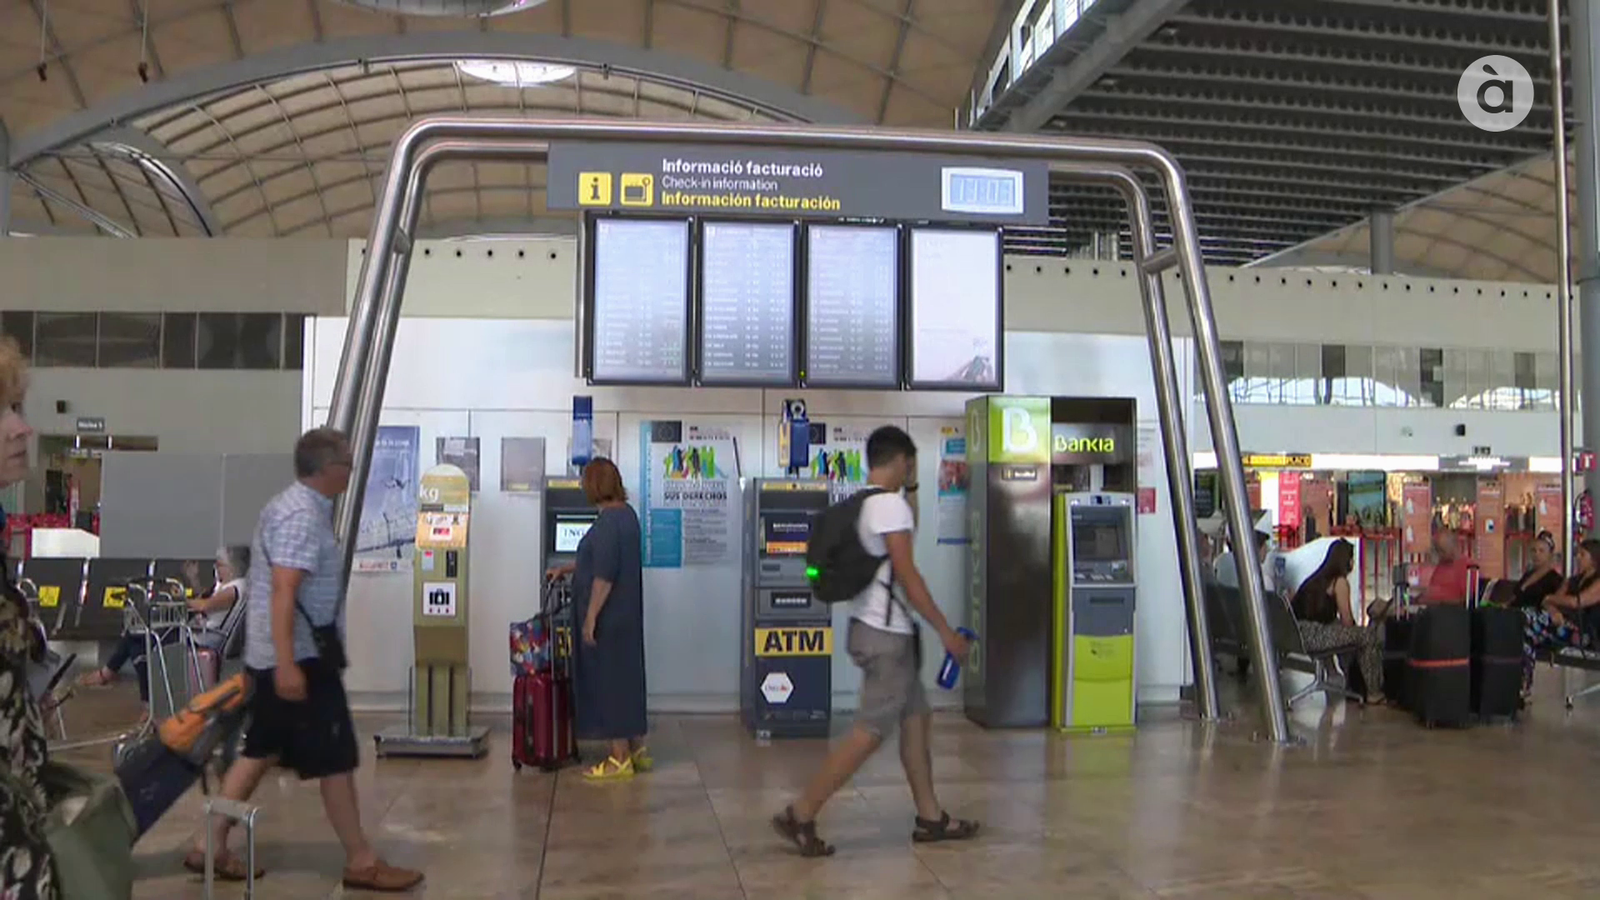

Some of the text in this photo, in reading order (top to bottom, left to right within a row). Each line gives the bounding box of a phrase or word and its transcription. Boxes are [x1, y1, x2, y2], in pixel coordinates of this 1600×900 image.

[662, 158, 824, 177] Informació facturació
[662, 175, 778, 191] Check-in information
[662, 191, 841, 210] Información facturación
[1002, 407, 1038, 454] B
[1054, 434, 1115, 453] Bankia
[419, 484, 439, 503] kg
[664, 491, 727, 500] SUS DERECHOS
[763, 630, 825, 653] ATM
